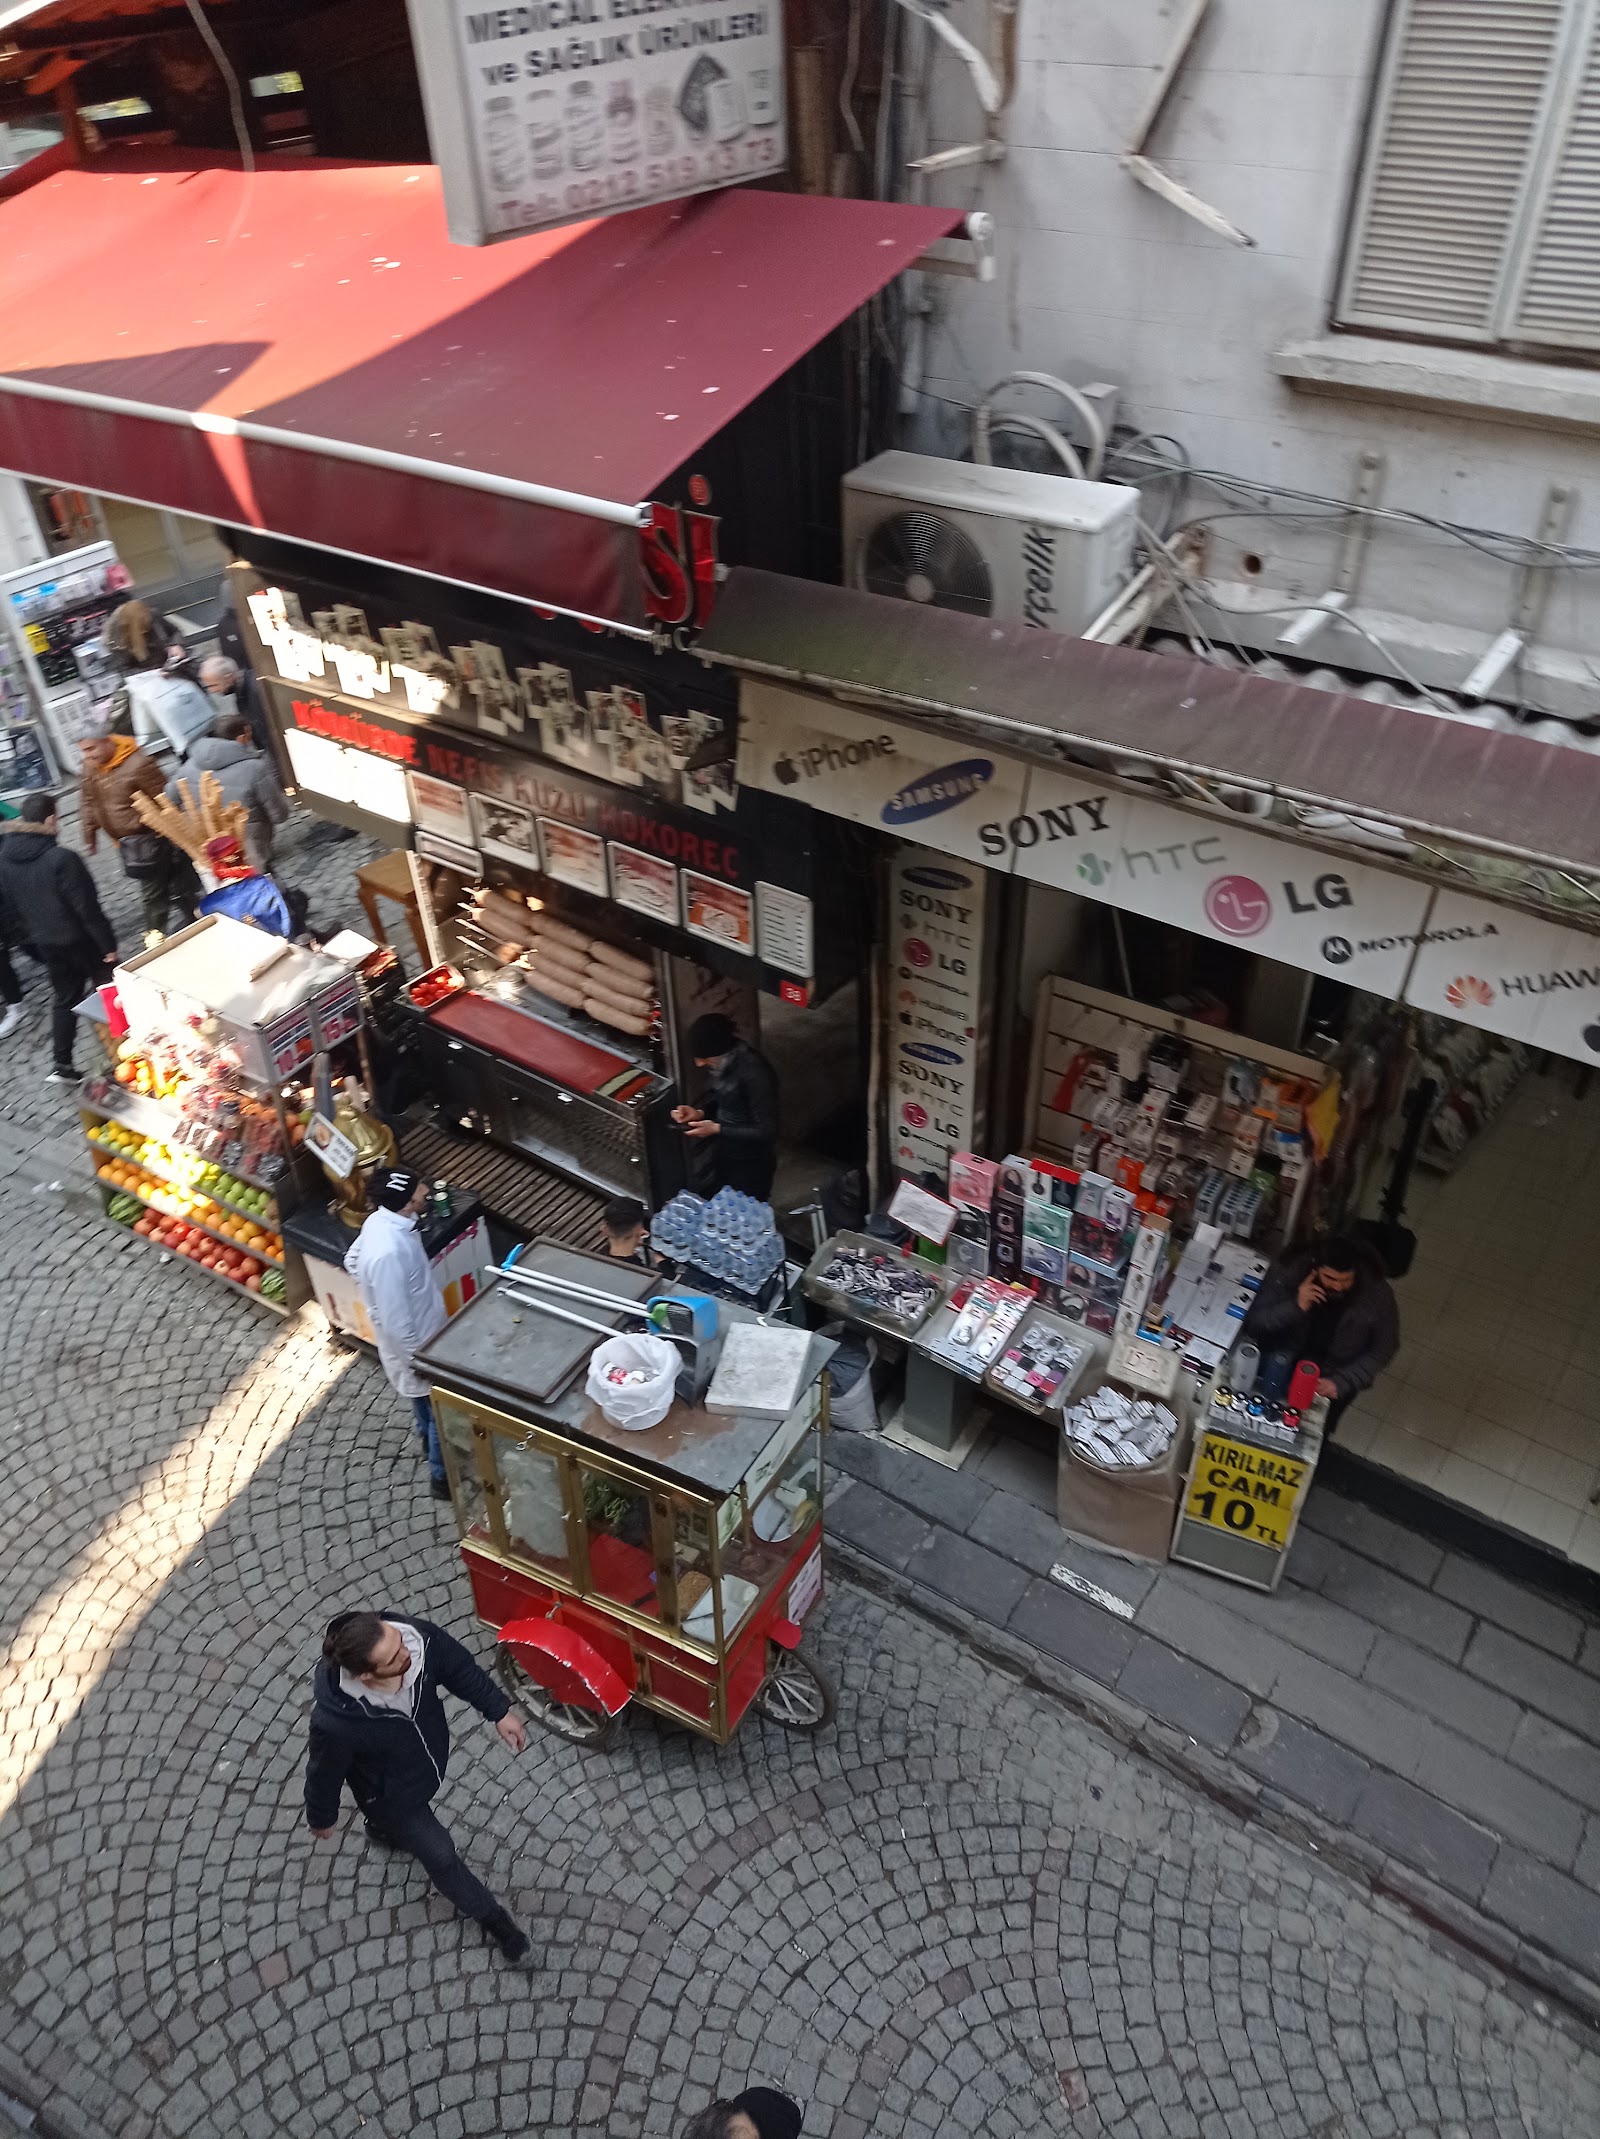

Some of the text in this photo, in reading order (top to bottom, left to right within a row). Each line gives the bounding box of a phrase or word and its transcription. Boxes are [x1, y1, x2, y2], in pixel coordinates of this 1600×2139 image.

[481, 62, 519, 86] ve
[525, 34, 633, 78] SAĞLIK
[1021, 527, 1058, 630] rçelik
[801, 734, 897, 779] iPhone
[889, 771, 985, 812] SAMSUNG
[977, 796, 1111, 857] SONY
[898, 888, 973, 925] SONY
[1282, 872, 1355, 915] LG
[1358, 922, 1500, 954] MOTOROLA
[938, 953, 967, 977] LG
[914, 1016, 968, 1047] iPhone
[898, 1060, 965, 1096] SONY
[934, 1117, 961, 1140] LG
[1202, 1440, 1304, 1488] KIRILMAZ
[1207, 1468, 1282, 1506] CAM
[1192, 1491, 1282, 1544] 10 TL
